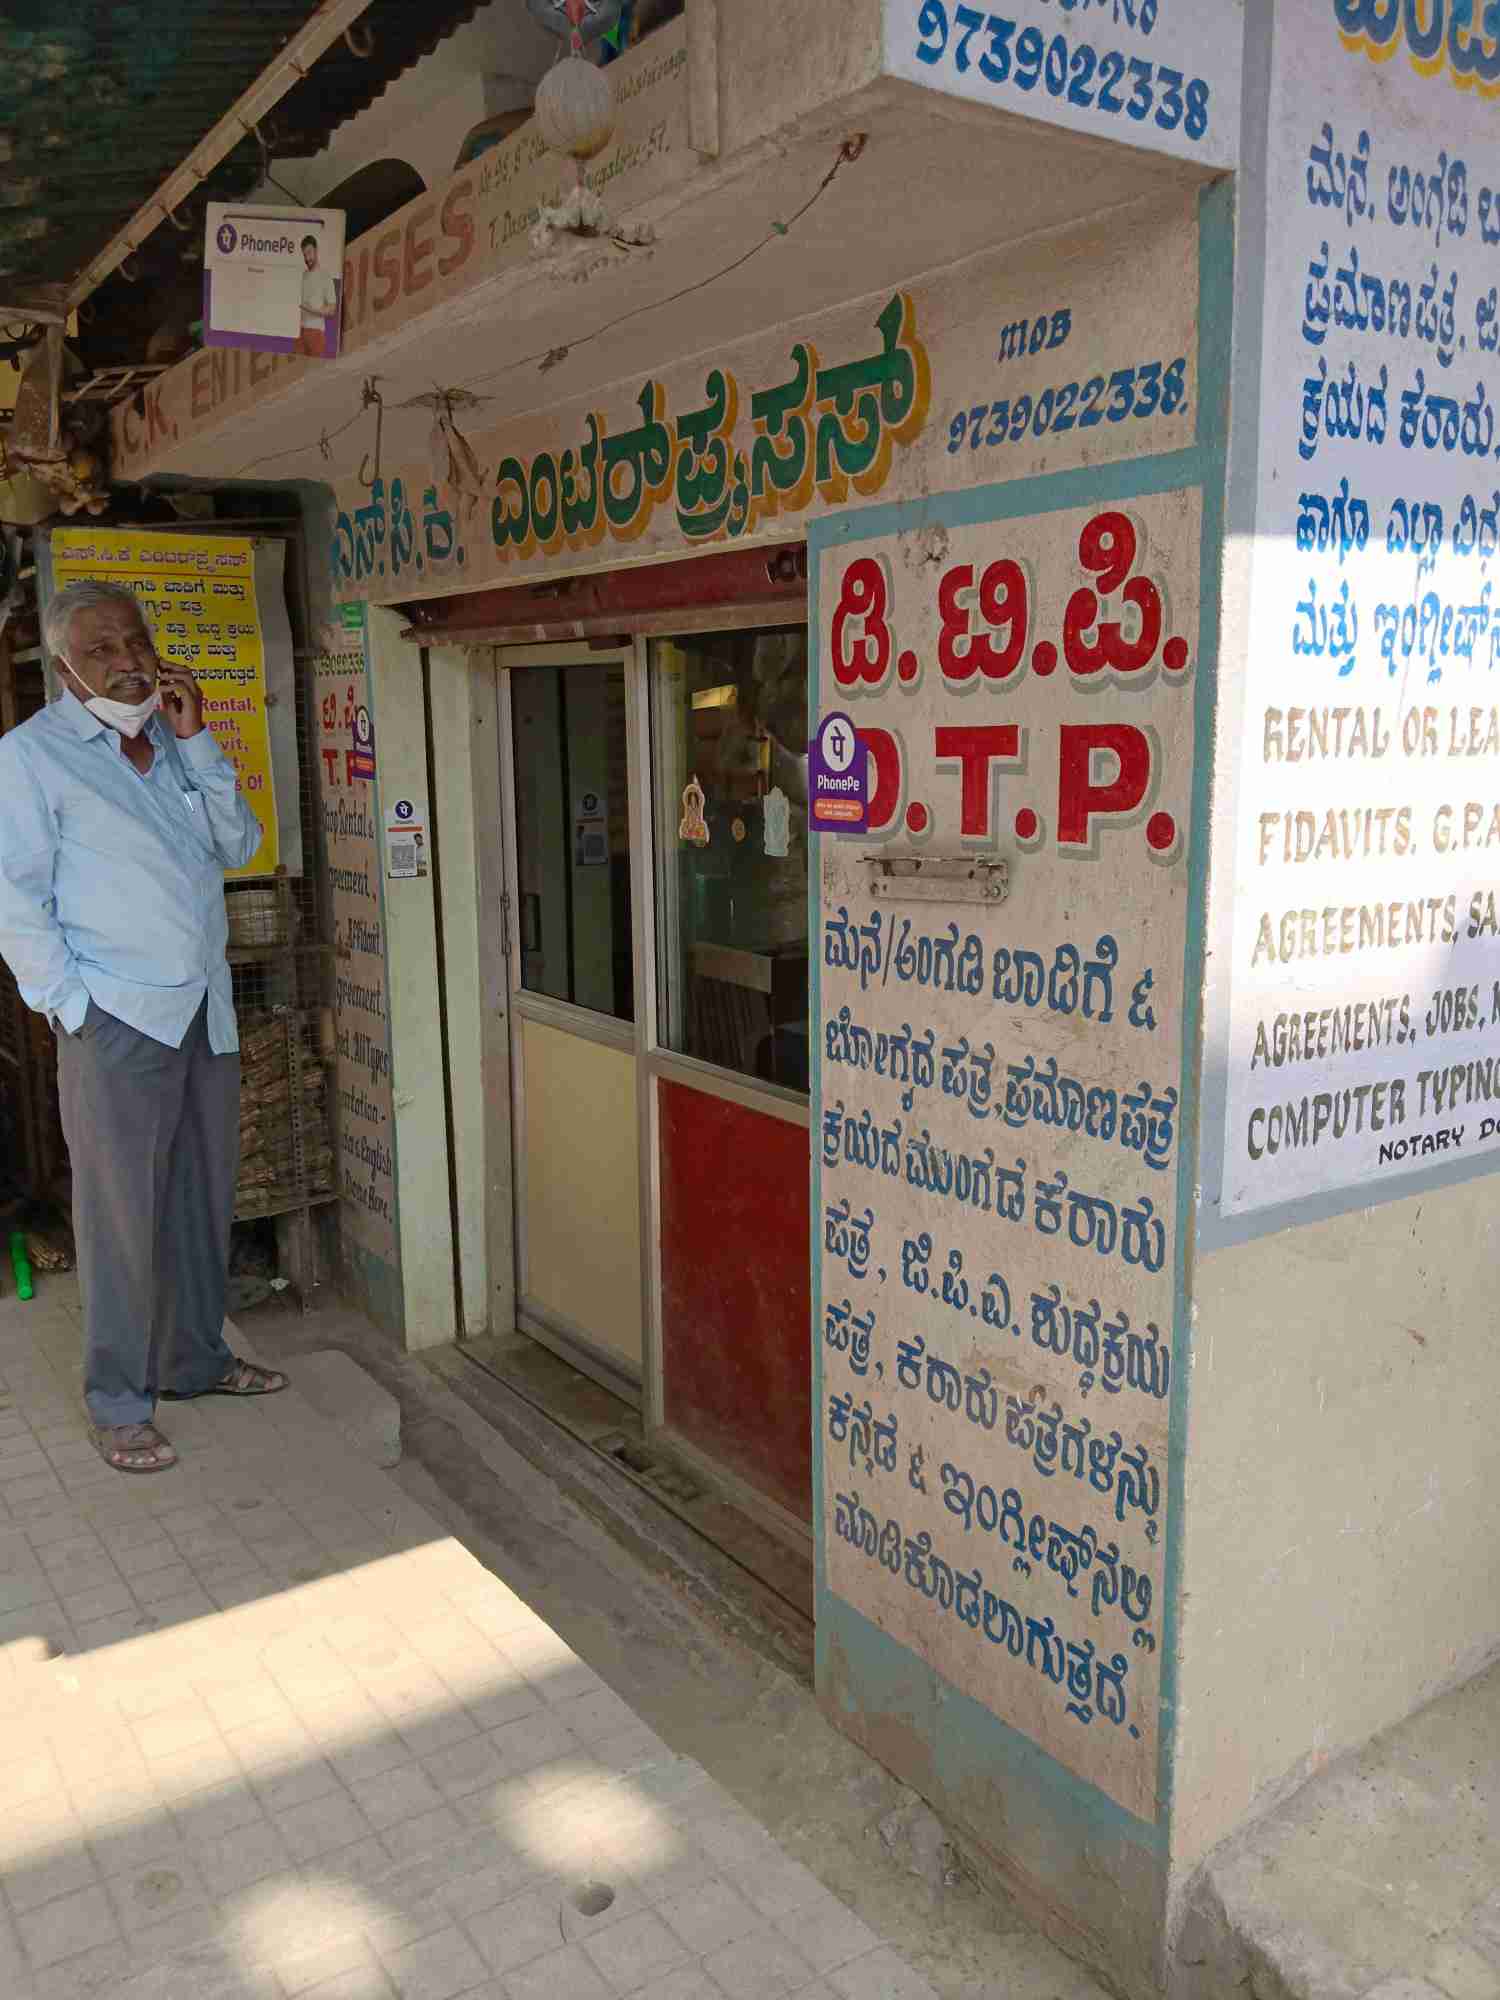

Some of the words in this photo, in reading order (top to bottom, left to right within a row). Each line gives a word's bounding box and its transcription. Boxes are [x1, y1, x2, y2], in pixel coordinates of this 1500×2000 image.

[914, 0, 1210, 141] 9739022338
[240, 233, 296, 254] PhonePe
[1292, 576, 1360, 677] ಮತ್ತು
[1261, 704, 1391, 765] RENTAL
[1401, 704, 1439, 758] OR
[816, 774, 861, 792] PhonePe
[992, 933, 1119, 1024] ಬಾಡಿಗೆ
[1250, 993, 1417, 1071] AGREEMENTS,
[1119, 1080, 1179, 1171] ಪತ್ರ
[1247, 1077, 1407, 1161] COMPUTER
[1378, 1123, 1465, 1166] NOTARY
[1034, 1170, 1166, 1274] ಕರಾರು
[896, 1335, 998, 1430] ಕರಾರು
[828, 1391, 898, 1479] ಕನ್ನಡ
